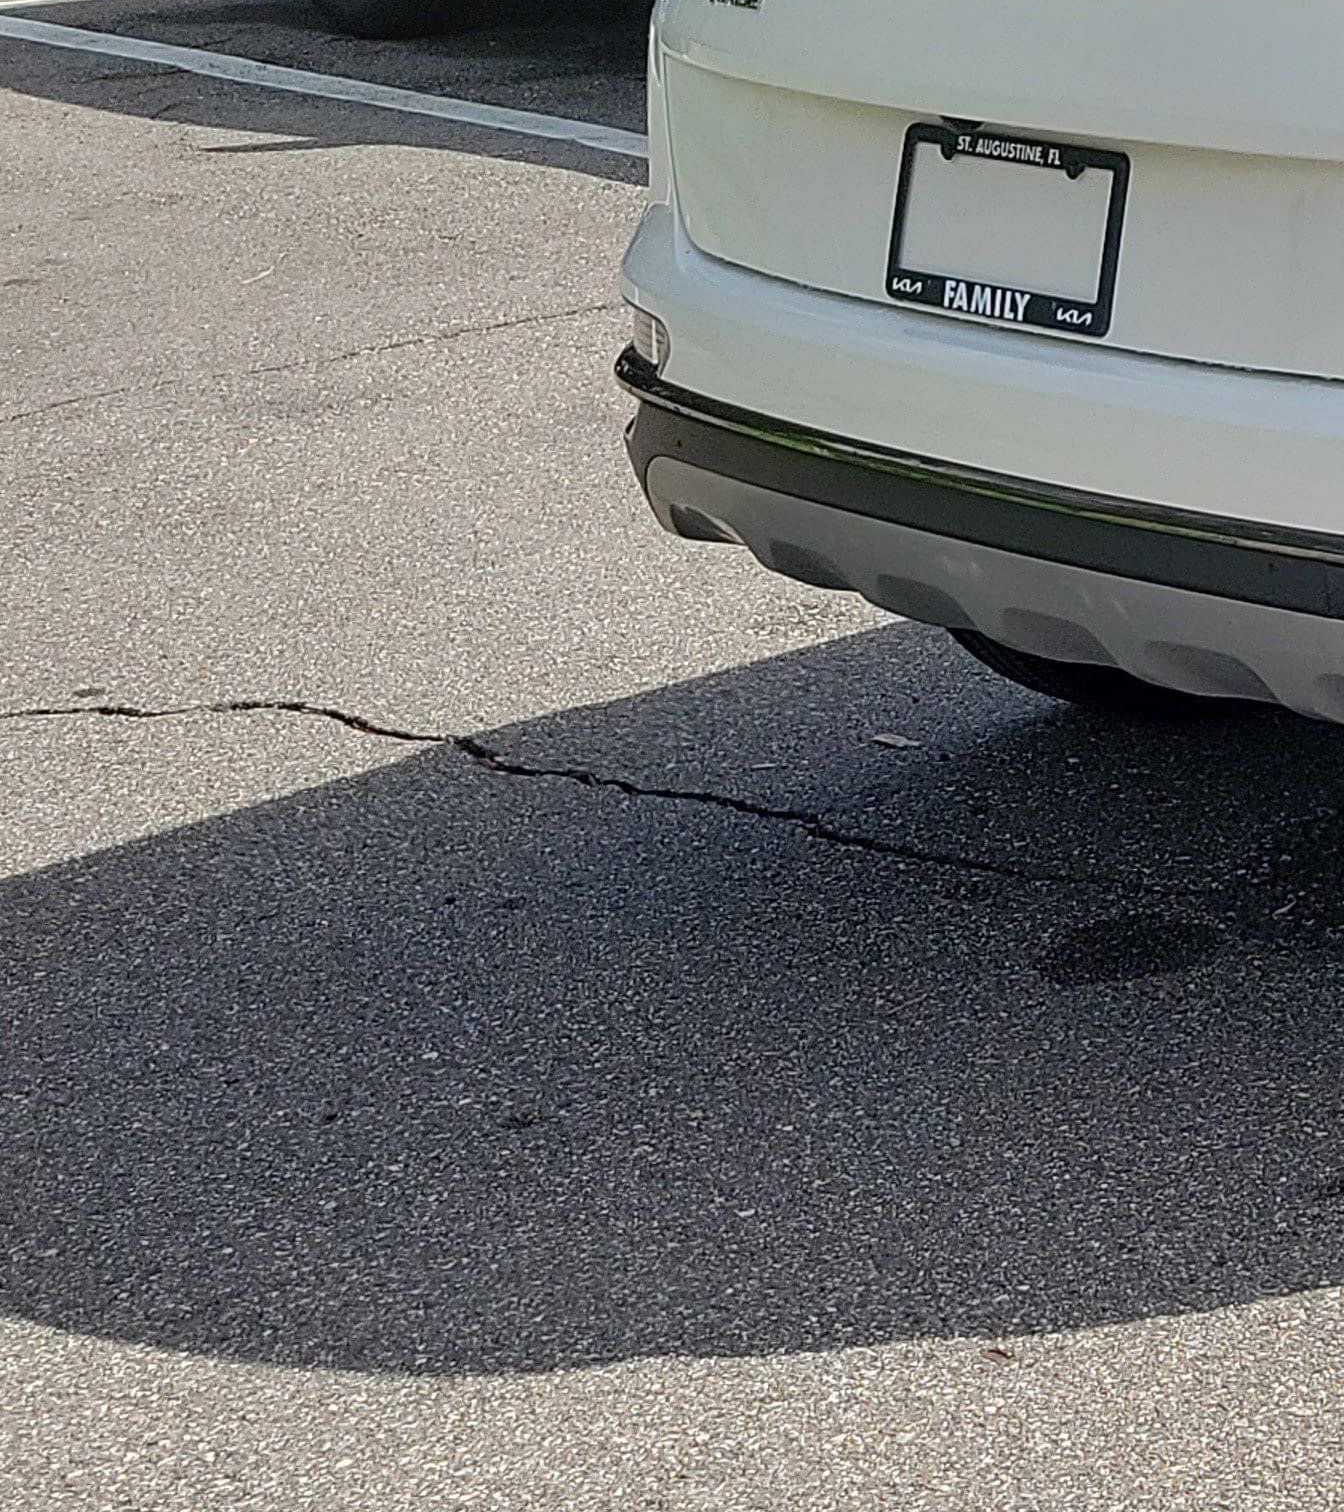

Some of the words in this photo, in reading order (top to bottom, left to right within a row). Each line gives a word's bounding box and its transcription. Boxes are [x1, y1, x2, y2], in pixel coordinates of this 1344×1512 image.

[957, 136, 973, 152] ST.
[975, 138, 1045, 165] AUGUSTINE,
[1048, 149, 1061, 165] FL
[943, 280, 1030, 322] FAMILY
